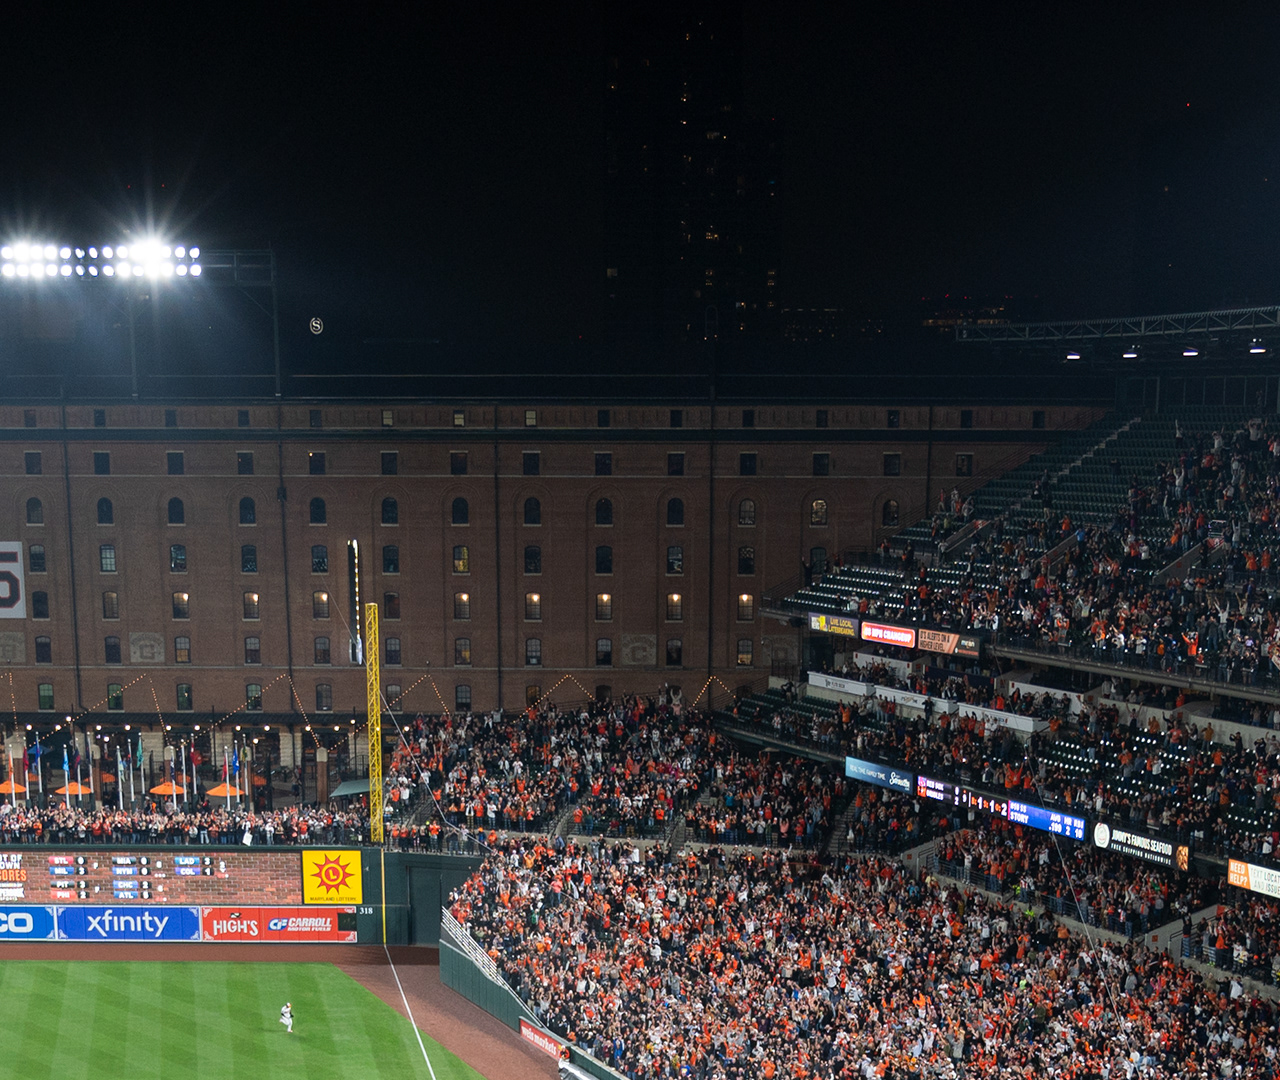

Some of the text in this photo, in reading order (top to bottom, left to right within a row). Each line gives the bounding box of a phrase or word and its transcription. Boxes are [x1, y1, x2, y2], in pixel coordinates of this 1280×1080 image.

[1010, 812, 1028, 824] STORY
[1150, 840, 1172, 855] SEAFOOD
[11, 854, 22, 862] OF
[1230, 862, 1246, 874] NEED
[1230, 873, 1247, 886] HELP?
[359, 907, 373, 915] 318
[87, 910, 170, 937] xfinity
[213, 918, 259, 936] HIGH'S
[288, 918, 332, 927] CARROLL
